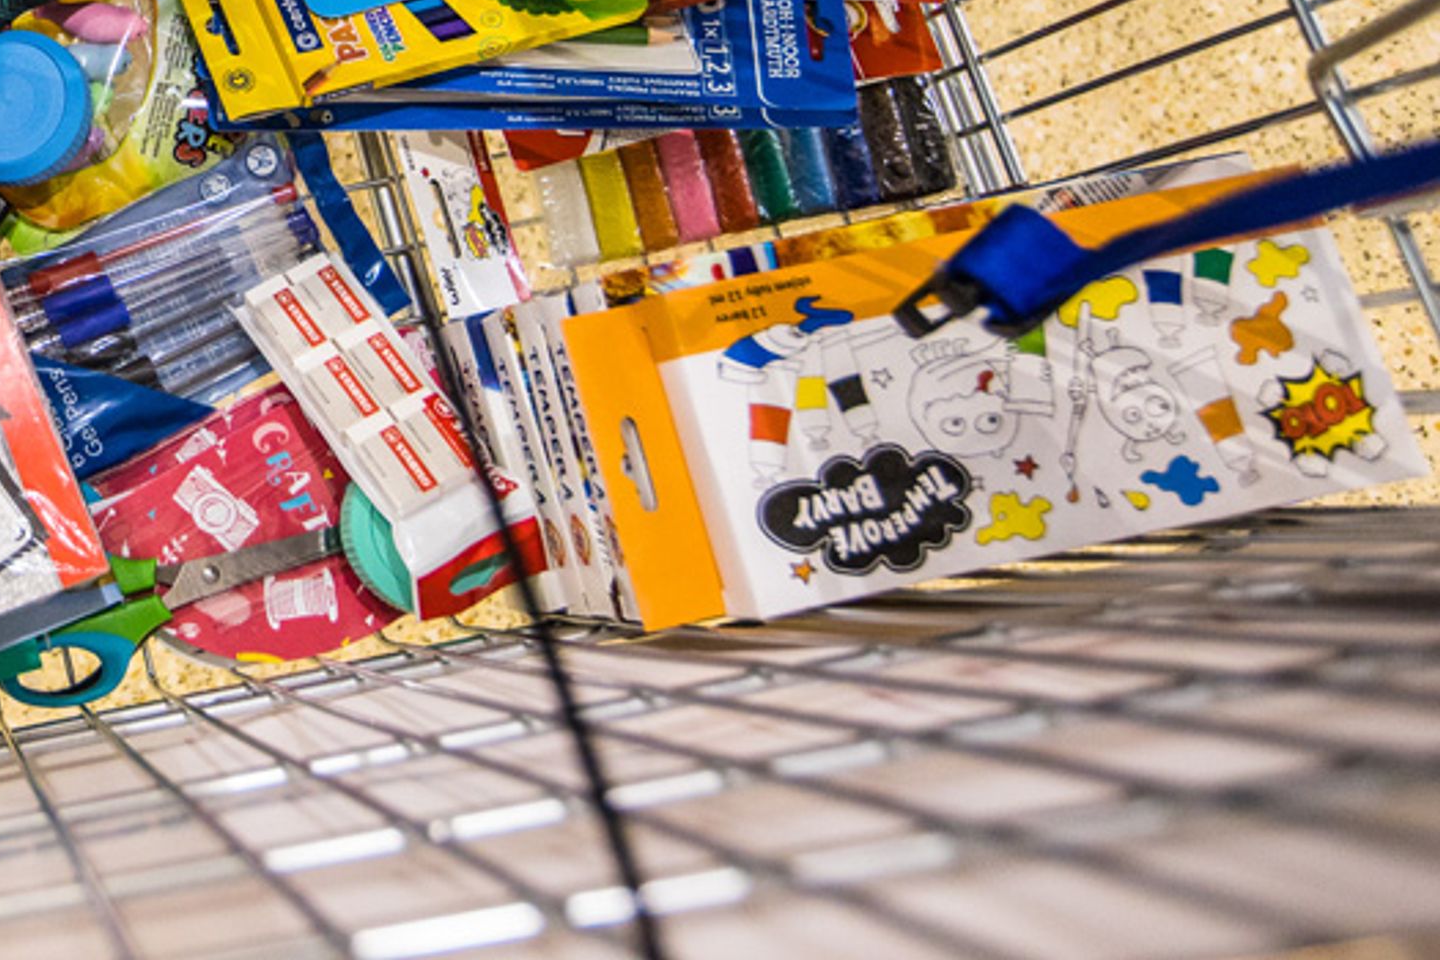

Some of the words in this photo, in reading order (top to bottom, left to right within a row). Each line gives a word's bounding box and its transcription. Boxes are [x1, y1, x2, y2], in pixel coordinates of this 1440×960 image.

[48, 367, 80, 423] Pens
[528, 344, 574, 501] TEMPERA
[557, 342, 605, 501] TEMPERA
[81, 423, 104, 458] Gel
[793, 473, 886, 530] BARVY
[828, 466, 959, 561] TEMPEROVÉ
